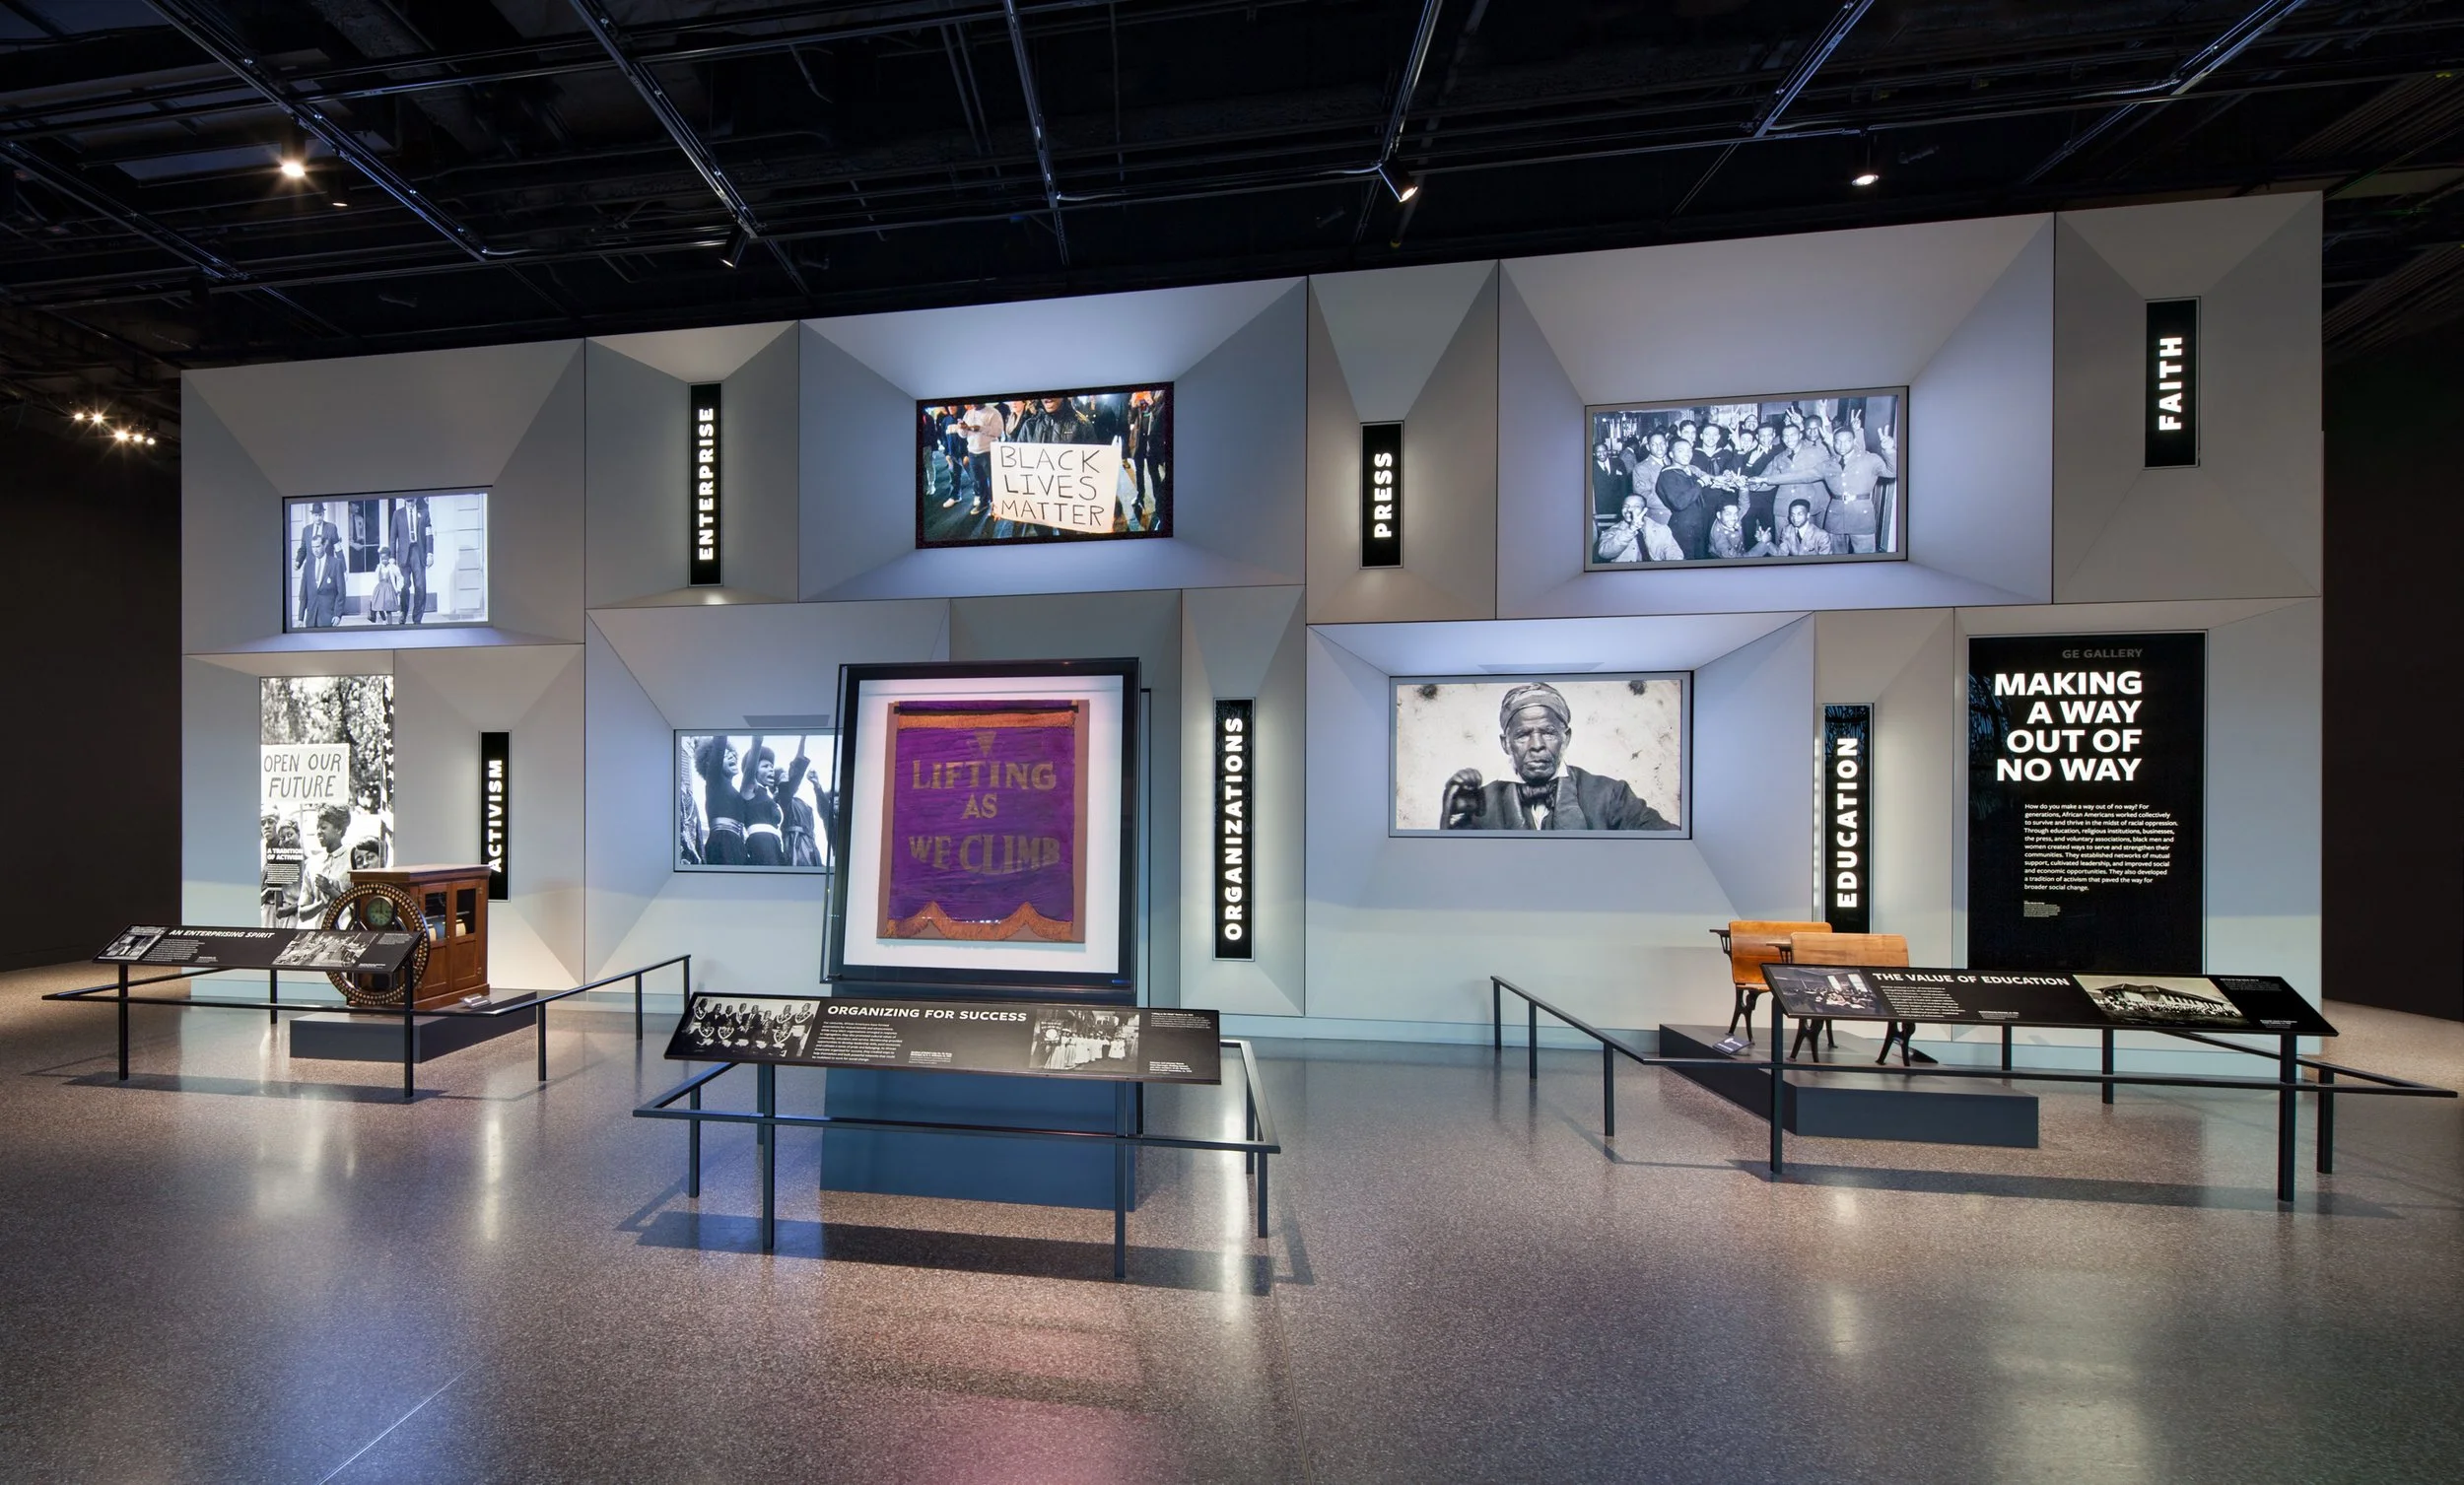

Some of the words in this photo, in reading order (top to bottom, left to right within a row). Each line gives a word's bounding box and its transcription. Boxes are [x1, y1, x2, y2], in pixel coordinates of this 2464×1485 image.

[2158, 337, 2182, 431] FAITH
[1000, 445, 1100, 474] BLACK
[699, 408, 714, 560] ENTERPRISE
[1004, 474, 1097, 501] LIVES
[1374, 452, 1393, 538] PRESS
[1000, 500, 1105, 526] MATTER
[2063, 649, 2080, 659] GE
[2084, 647, 2143, 658] GALLERY
[1994, 671, 2142, 696] MAKING
[2026, 701, 2053, 723] A
[2060, 700, 2142, 723] WAY
[2007, 729, 2085, 753] OUT
[2092, 728, 2142, 753] OF
[264, 754, 300, 773] OPEN
[308, 753, 342, 772] OUR
[913, 760, 1057, 789] LIFTING
[1997, 758, 2052, 781] NO
[2060, 758, 2142, 781] WAY
[268, 775, 336, 799] FUTURE
[488, 760, 503, 873] ACTIVISM
[961, 793, 997, 819] AS
[1224, 717, 1243, 941] ORGANIZATIONS
[1836, 738, 1858, 908] EDUCATION
[908, 836, 951, 869] WE
[959, 835, 1061, 874] CLIMB
[1873, 973, 1904, 981] THE
[1905, 974, 1954, 982] VALUE
[1956, 975, 1976, 983] OF
[1981, 976, 2070, 985] EDUCATION
[827, 1006, 920, 1018] ORGANIZING
[924, 1009, 954, 1019] FOR
[959, 1010, 1027, 1022] SUCCESS
